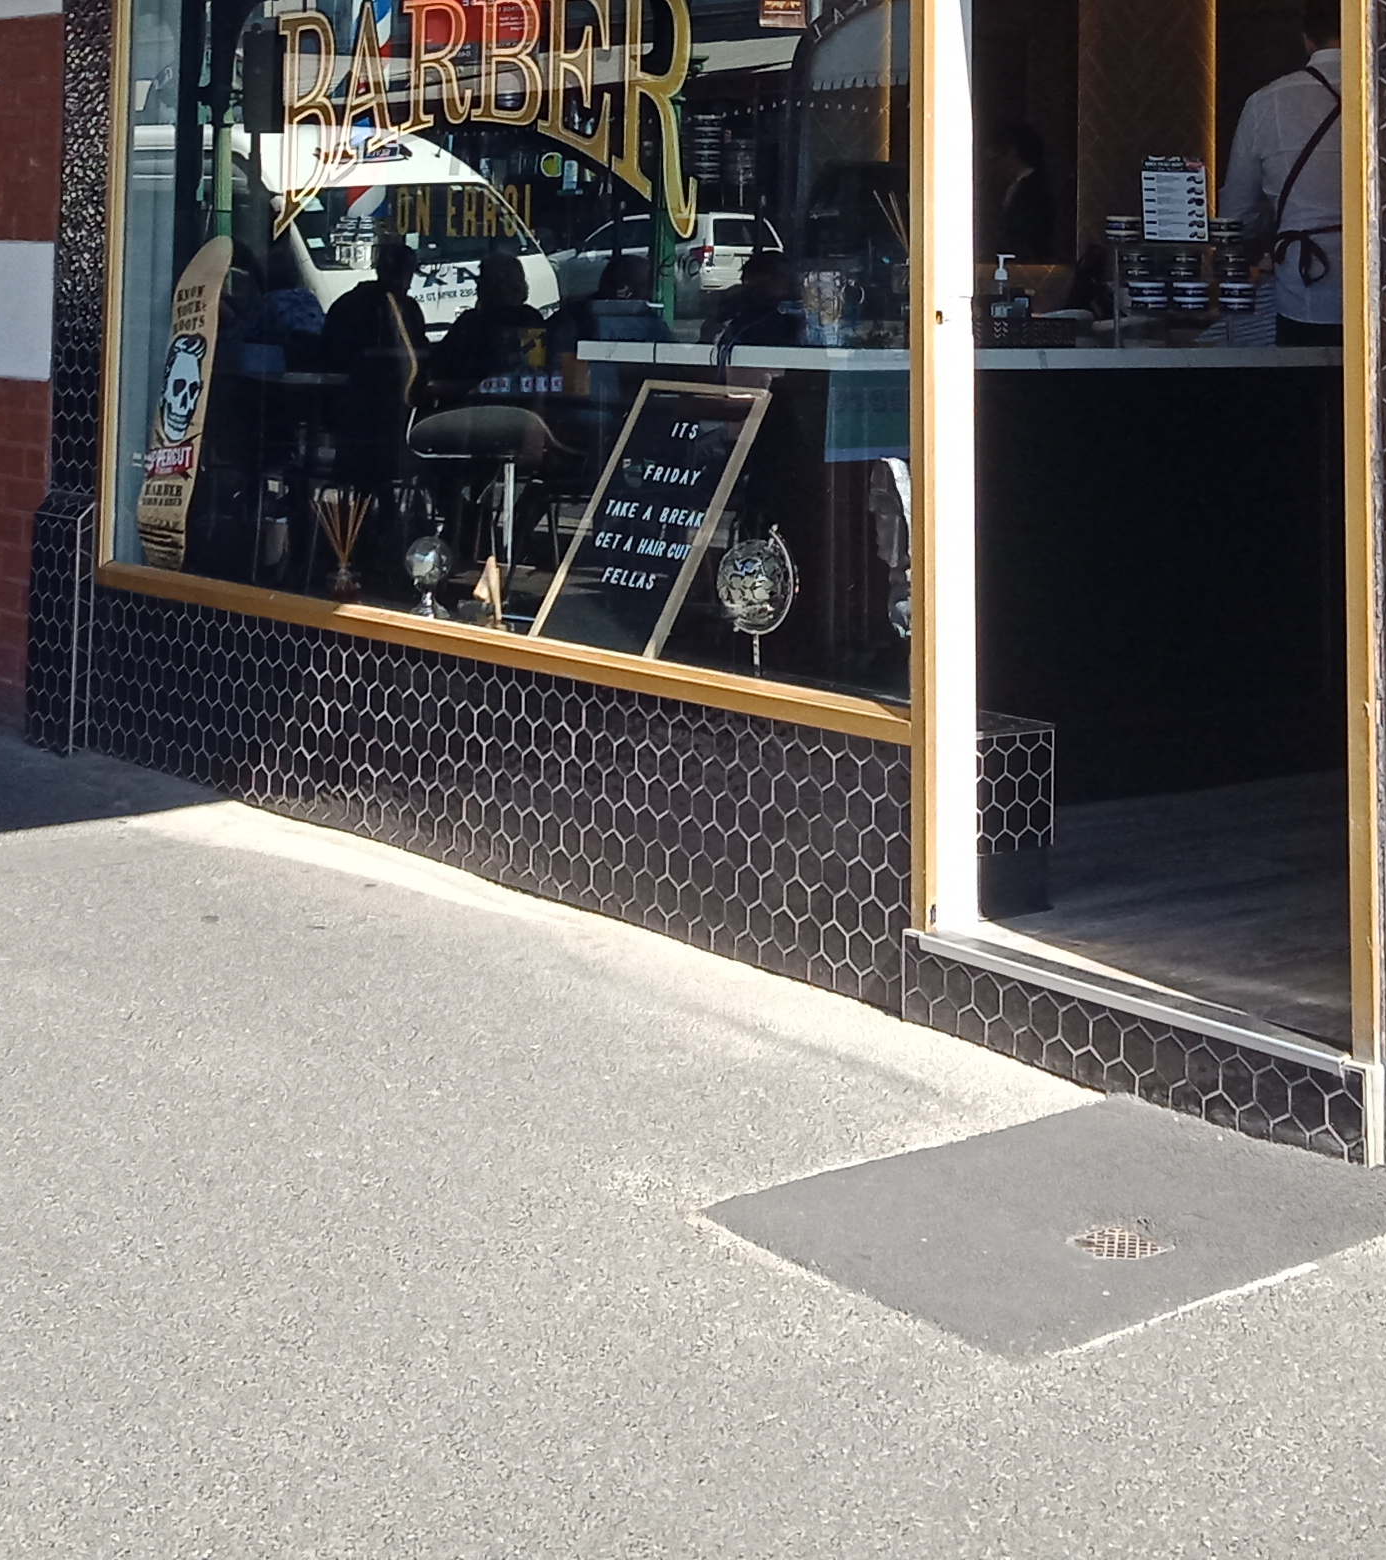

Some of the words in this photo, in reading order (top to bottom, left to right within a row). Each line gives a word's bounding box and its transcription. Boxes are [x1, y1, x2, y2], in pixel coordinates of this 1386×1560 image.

[397, 187, 431, 237] ON
[446, 183, 536, 238] ERROL
[177, 284, 206, 302] KNOW
[173, 314, 205, 335] ROOTS
[671, 422, 699, 439] ITS
[643, 464, 701, 486] FRIDAY
[605, 499, 639, 518] TAKE
[642, 505, 653, 521] A
[659, 507, 706, 527] BREAK
[595, 532, 622, 549] GET
[623, 536, 634, 551] A
[636, 538, 666, 557] HAIR
[667, 544, 693, 560] CUT
[601, 567, 657, 590] FELLAS
